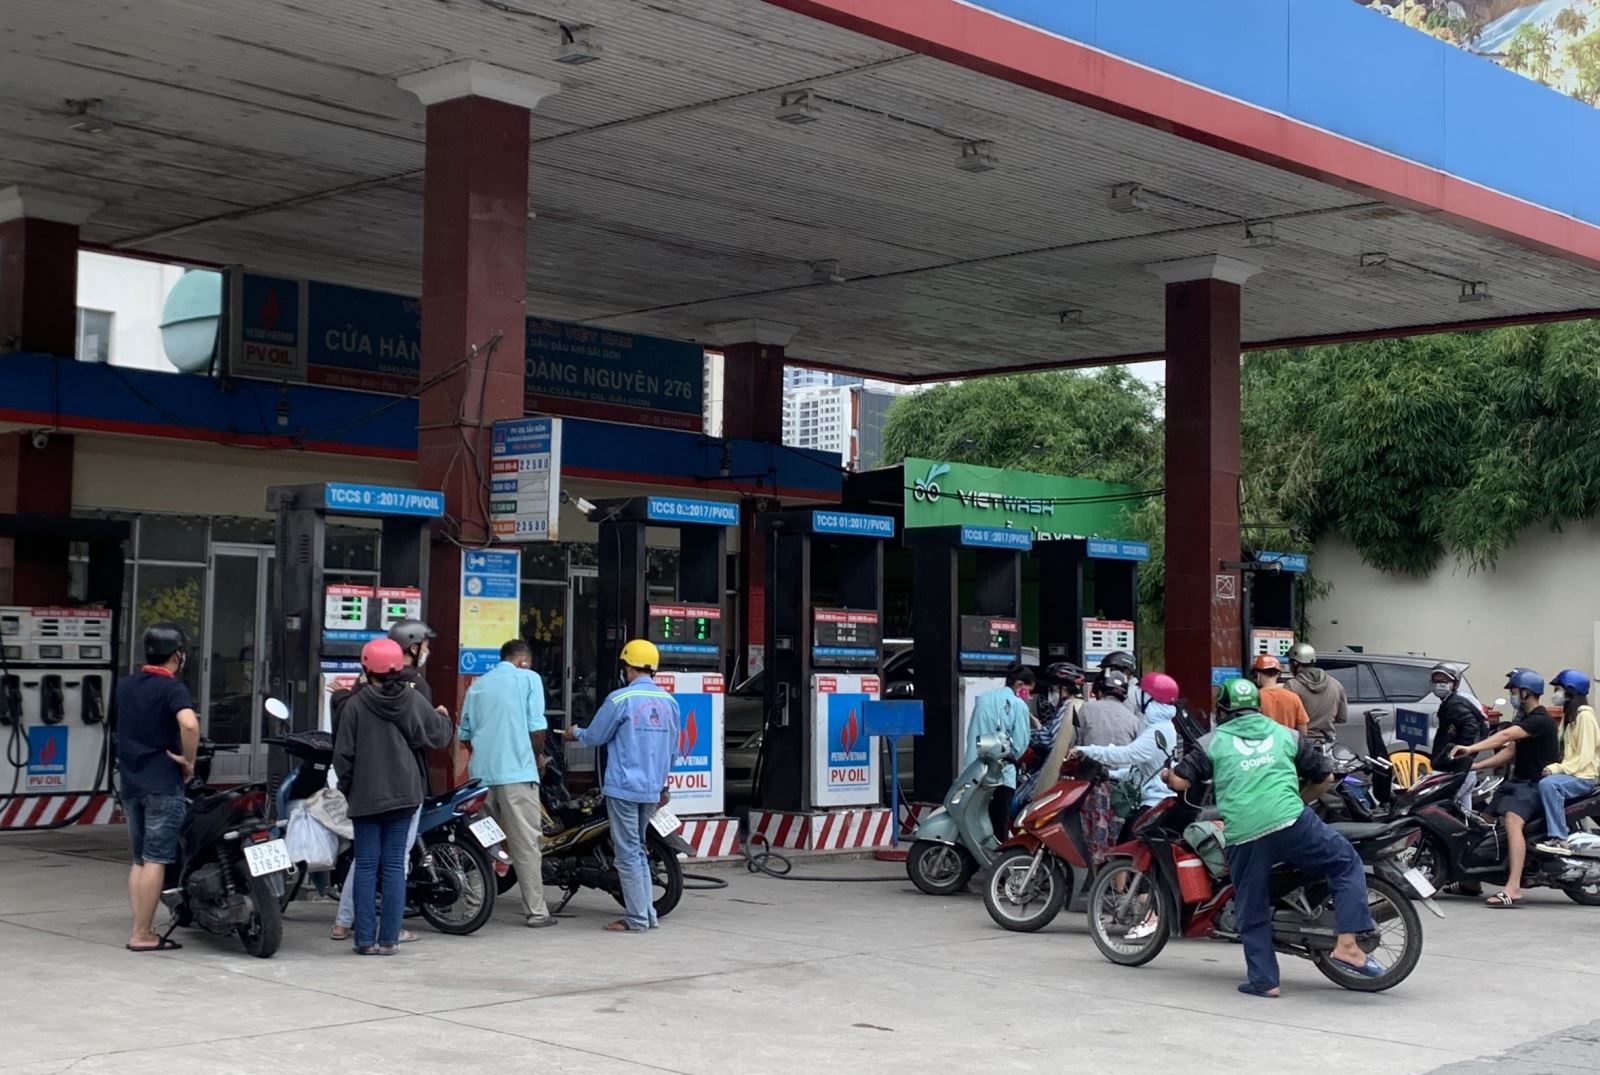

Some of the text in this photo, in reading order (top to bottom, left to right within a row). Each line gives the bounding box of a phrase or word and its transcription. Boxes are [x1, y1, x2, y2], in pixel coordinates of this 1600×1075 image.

[325, 323, 372, 354] CỬA
[379, 334, 421, 361] HÀN
[525, 355, 692, 399] OÀNG NGUYÊN 276
[331, 488, 360, 504] TCCS
[652, 501, 675, 515] TCCS
[816, 515, 838, 527] TCCS
[964, 529, 982, 541] TCCS
[1240, 753, 1275, 771] gojek
[667, 774, 708, 789] PV OIL
[832, 769, 866, 782] PV OIL
